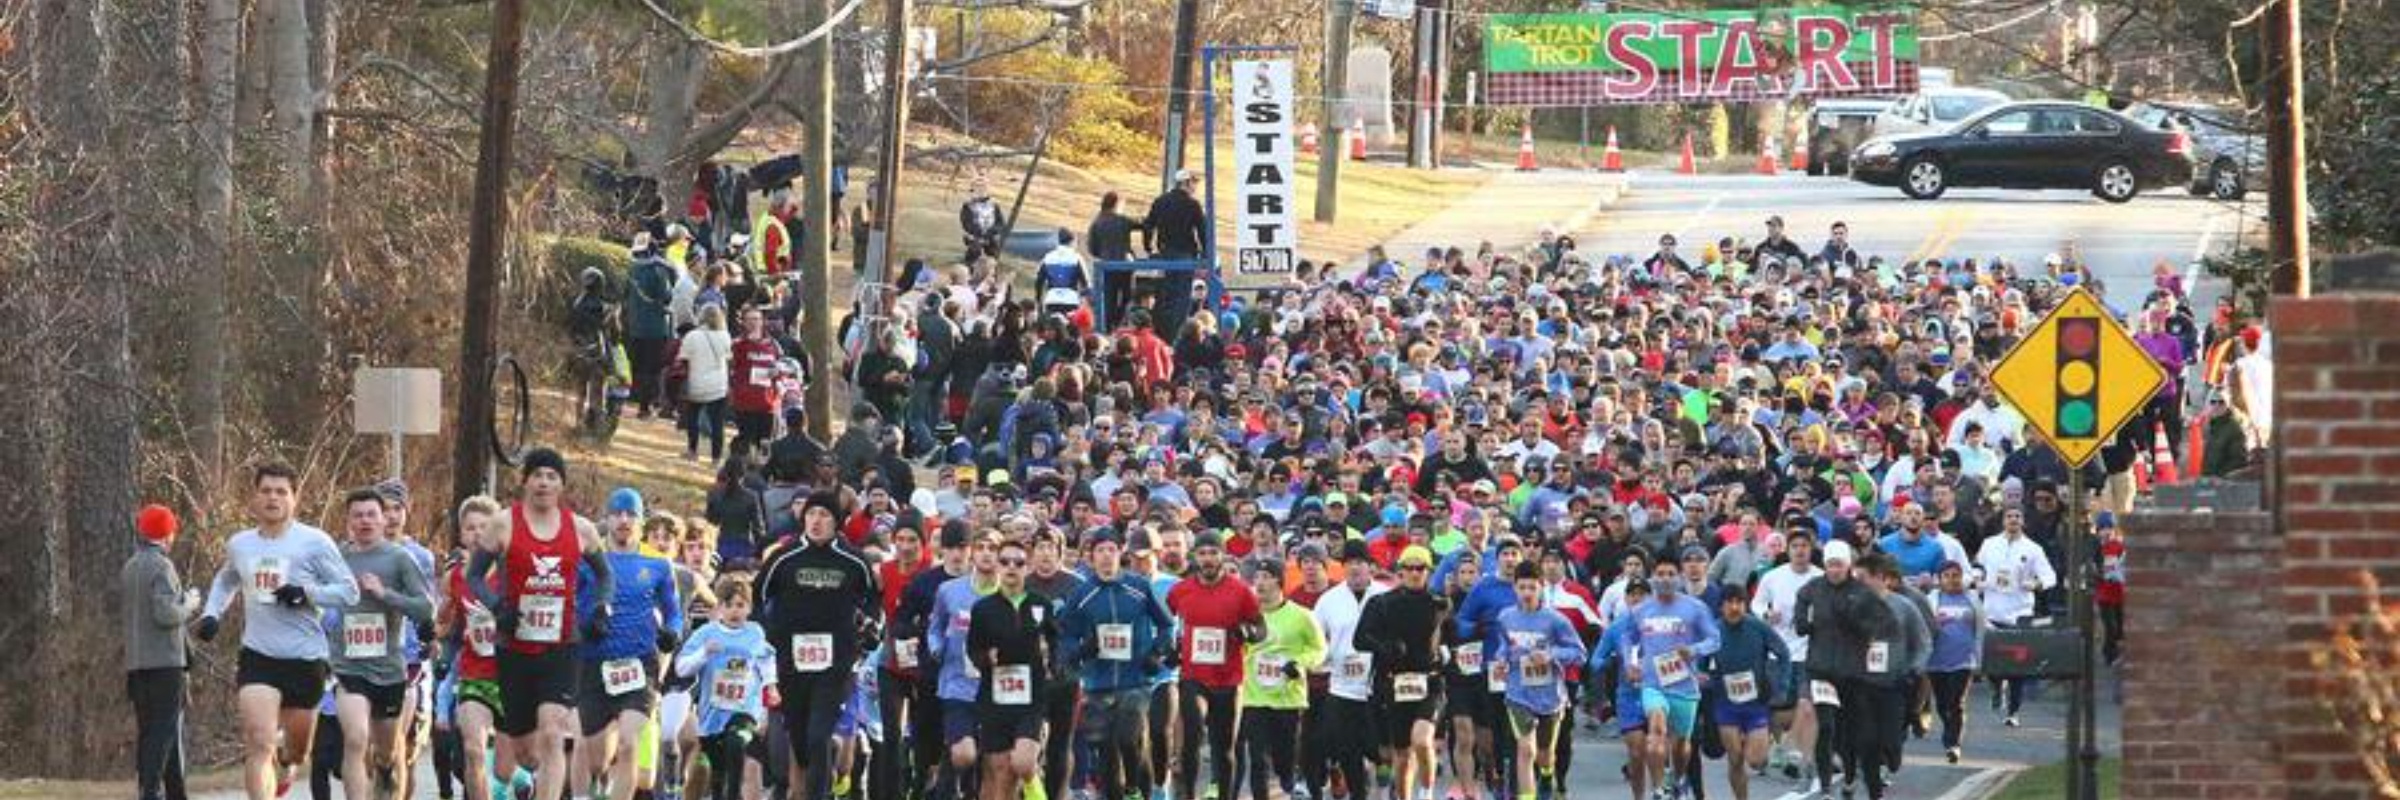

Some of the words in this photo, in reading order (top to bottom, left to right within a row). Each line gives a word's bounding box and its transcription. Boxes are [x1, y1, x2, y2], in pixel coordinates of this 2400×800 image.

[1490, 24, 1600, 45] TARTAN
[1528, 44, 1595, 66] TROT
[1604, 14, 1909, 99] START
[1246, 102, 1283, 245] START
